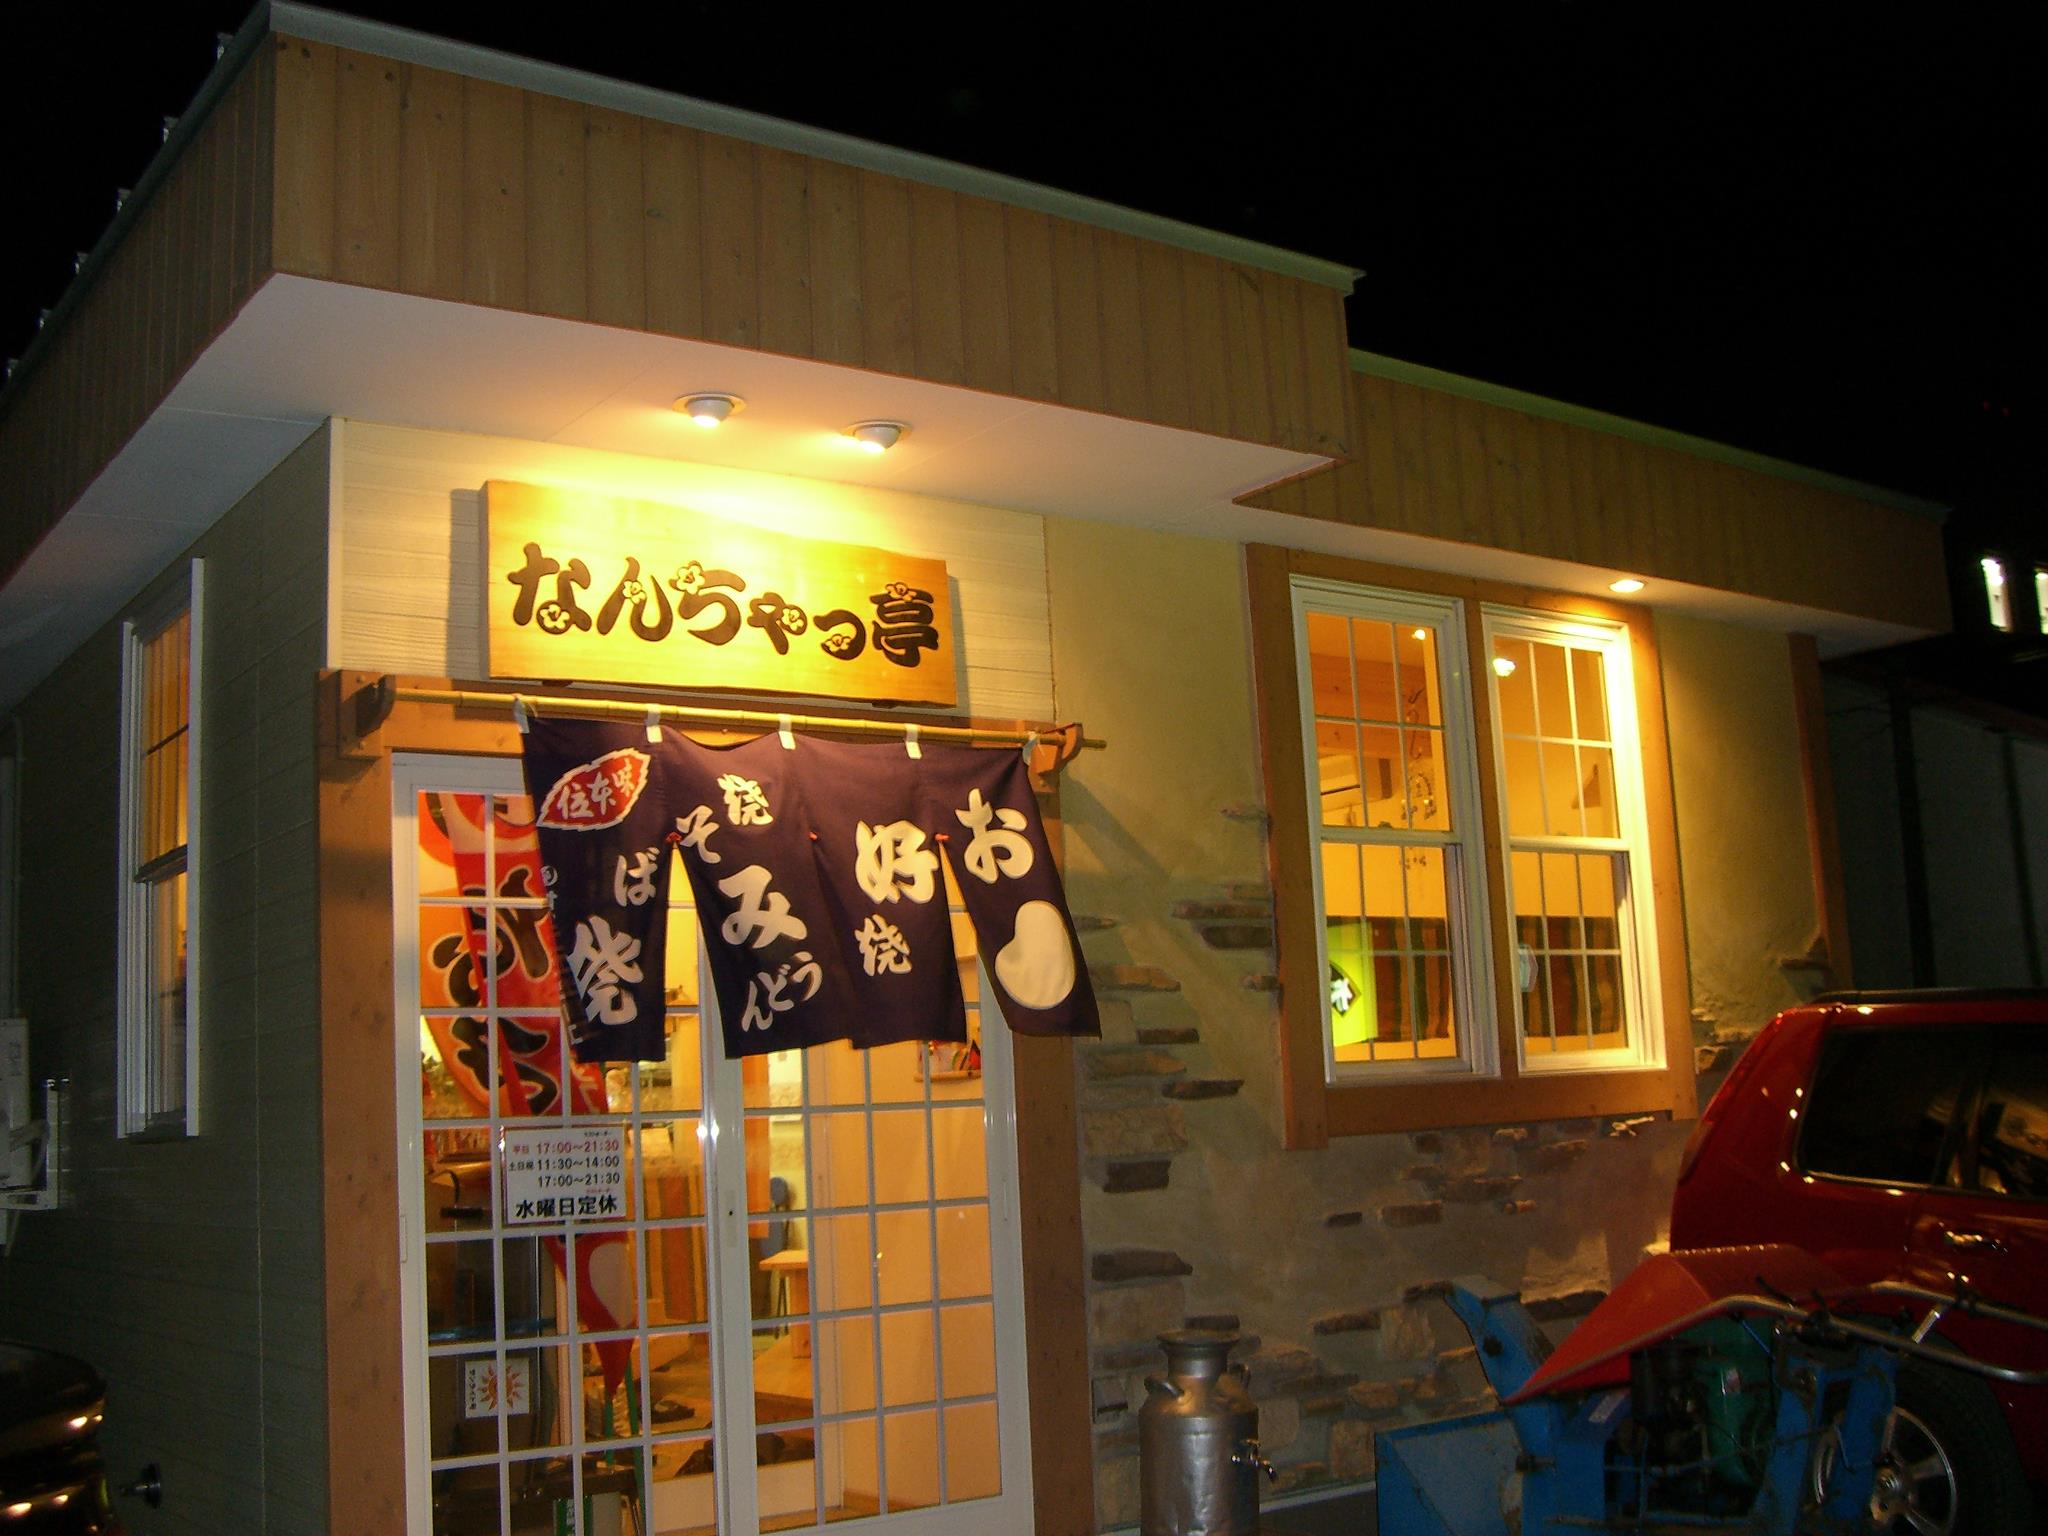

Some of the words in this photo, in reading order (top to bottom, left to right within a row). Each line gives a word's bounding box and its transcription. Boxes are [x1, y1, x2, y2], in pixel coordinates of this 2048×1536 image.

[506, 542, 940, 667] なんちゃっ亭
[515, 1194, 618, 1219] 水曜日定休
